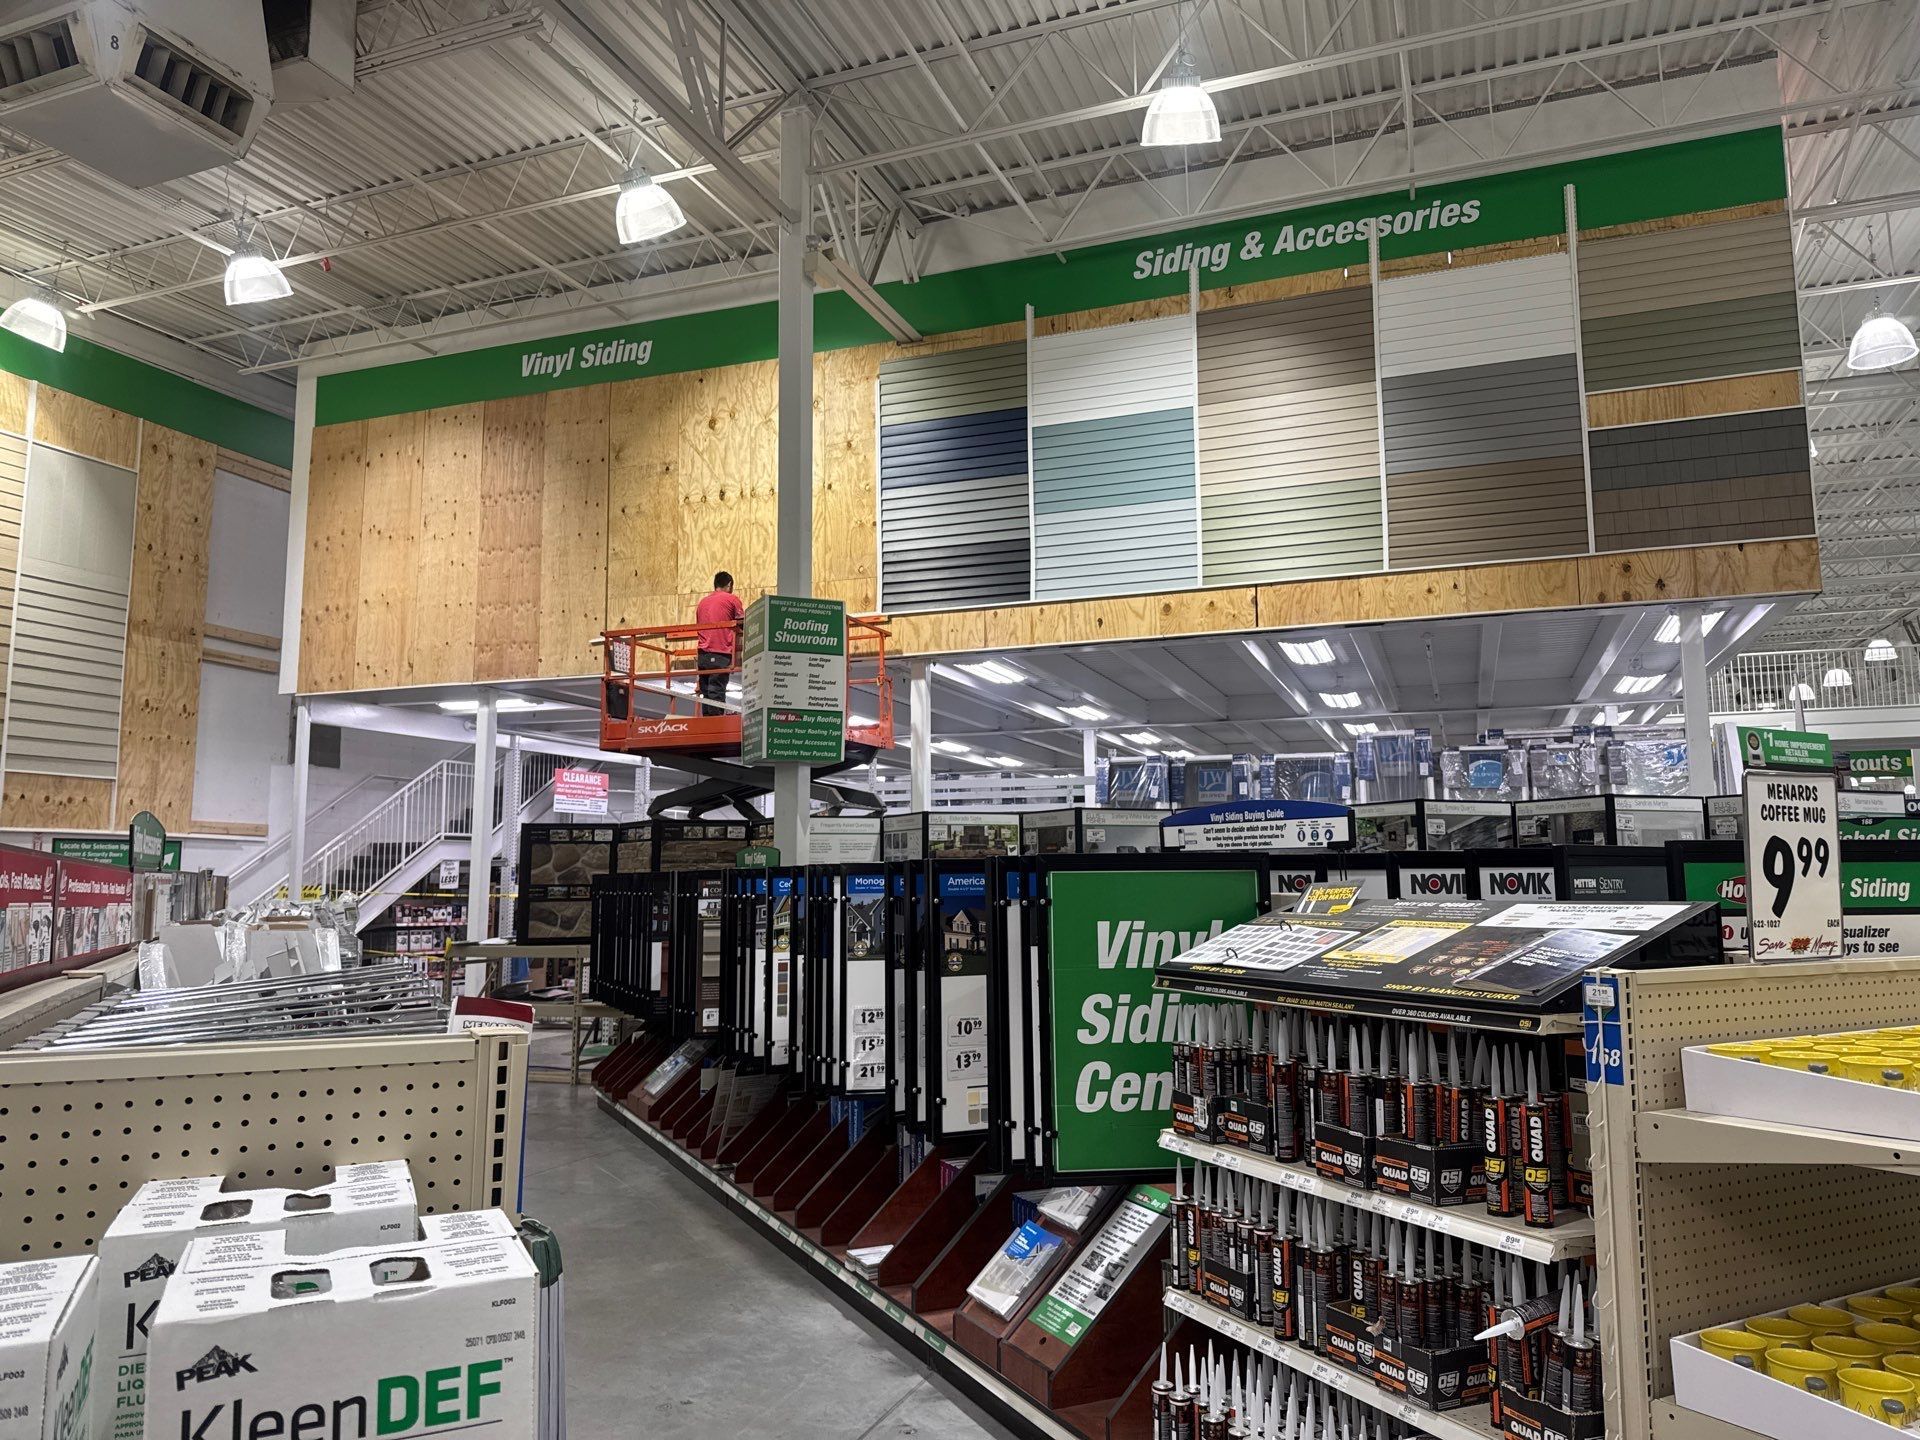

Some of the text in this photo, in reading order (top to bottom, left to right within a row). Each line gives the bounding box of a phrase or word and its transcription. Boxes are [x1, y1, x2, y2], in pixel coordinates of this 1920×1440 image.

[110, 35, 119, 50] 8
[1133, 199, 1481, 280] Siding & Accessories
[521, 339, 653, 378] Vinyl Siding
[784, 618, 829, 634] Roofing
[774, 631, 838, 646] Showroom
[816, 716, 841, 724] Roofing
[638, 722, 688, 734] SKYJACK
[562, 772, 602, 785] CLEARANCE
[1767, 783, 1818, 802] MENARDS
[1210, 809, 1284, 822] Vinyl Siding Buying Guide
[1761, 804, 1826, 824] COFFEE MUG
[1275, 824, 1286, 832] buy?
[440, 875, 458, 884] LESS!
[855, 877, 884, 887] Monog
[948, 877, 985, 886] America
[1490, 873, 1552, 895] NOVIK
[1574, 877, 1624, 889] MITTEN SENTRY
[1721, 880, 1746, 898] Ho
[1850, 878, 1910, 901] Siding
[1754, 919, 1840, 928] 622-1027 EACH
[1724, 927, 1730, 938] 1
[1757, 938, 1786, 955] Save
[1812, 934, 1838, 955] Money
[1864, 941, 1899, 953] to see
[1427, 987, 1521, 1000] MANUFACTURER
[1300, 999, 1332, 1008] COLOR-MATCH
[1332, 1002, 1355, 1010] SEALANT
[1417, 1010, 1438, 1019] COLORS
[1439, 1012, 1471, 1022] AVAILABLE
[1519, 1020, 1532, 1028] OSI
[1176, 1112, 1193, 1124] QUAD
[1228, 1121, 1265, 1134] QUAD OSI
[1485, 1108, 1496, 1152] QUAD
[1530, 1116, 1543, 1162] QUAD
[1321, 1151, 1362, 1168] QUAD OSI
[1382, 1166, 1430, 1183] QUAD OSI
[1441, 1170, 1463, 1184] OSI
[1274, 1247, 1282, 1286] QUAD
[1354, 1261, 1363, 1300] QUAD
[1210, 1282, 1244, 1301] QUAD OSI
[492, 1298, 516, 1308] KLF002
[1332, 1336, 1375, 1358] QUAD OSI
[176, 1353, 258, 1392] PEAK
[1380, 1362, 1428, 1388] QUAD OSI
[1438, 1372, 1459, 1387] OSI
